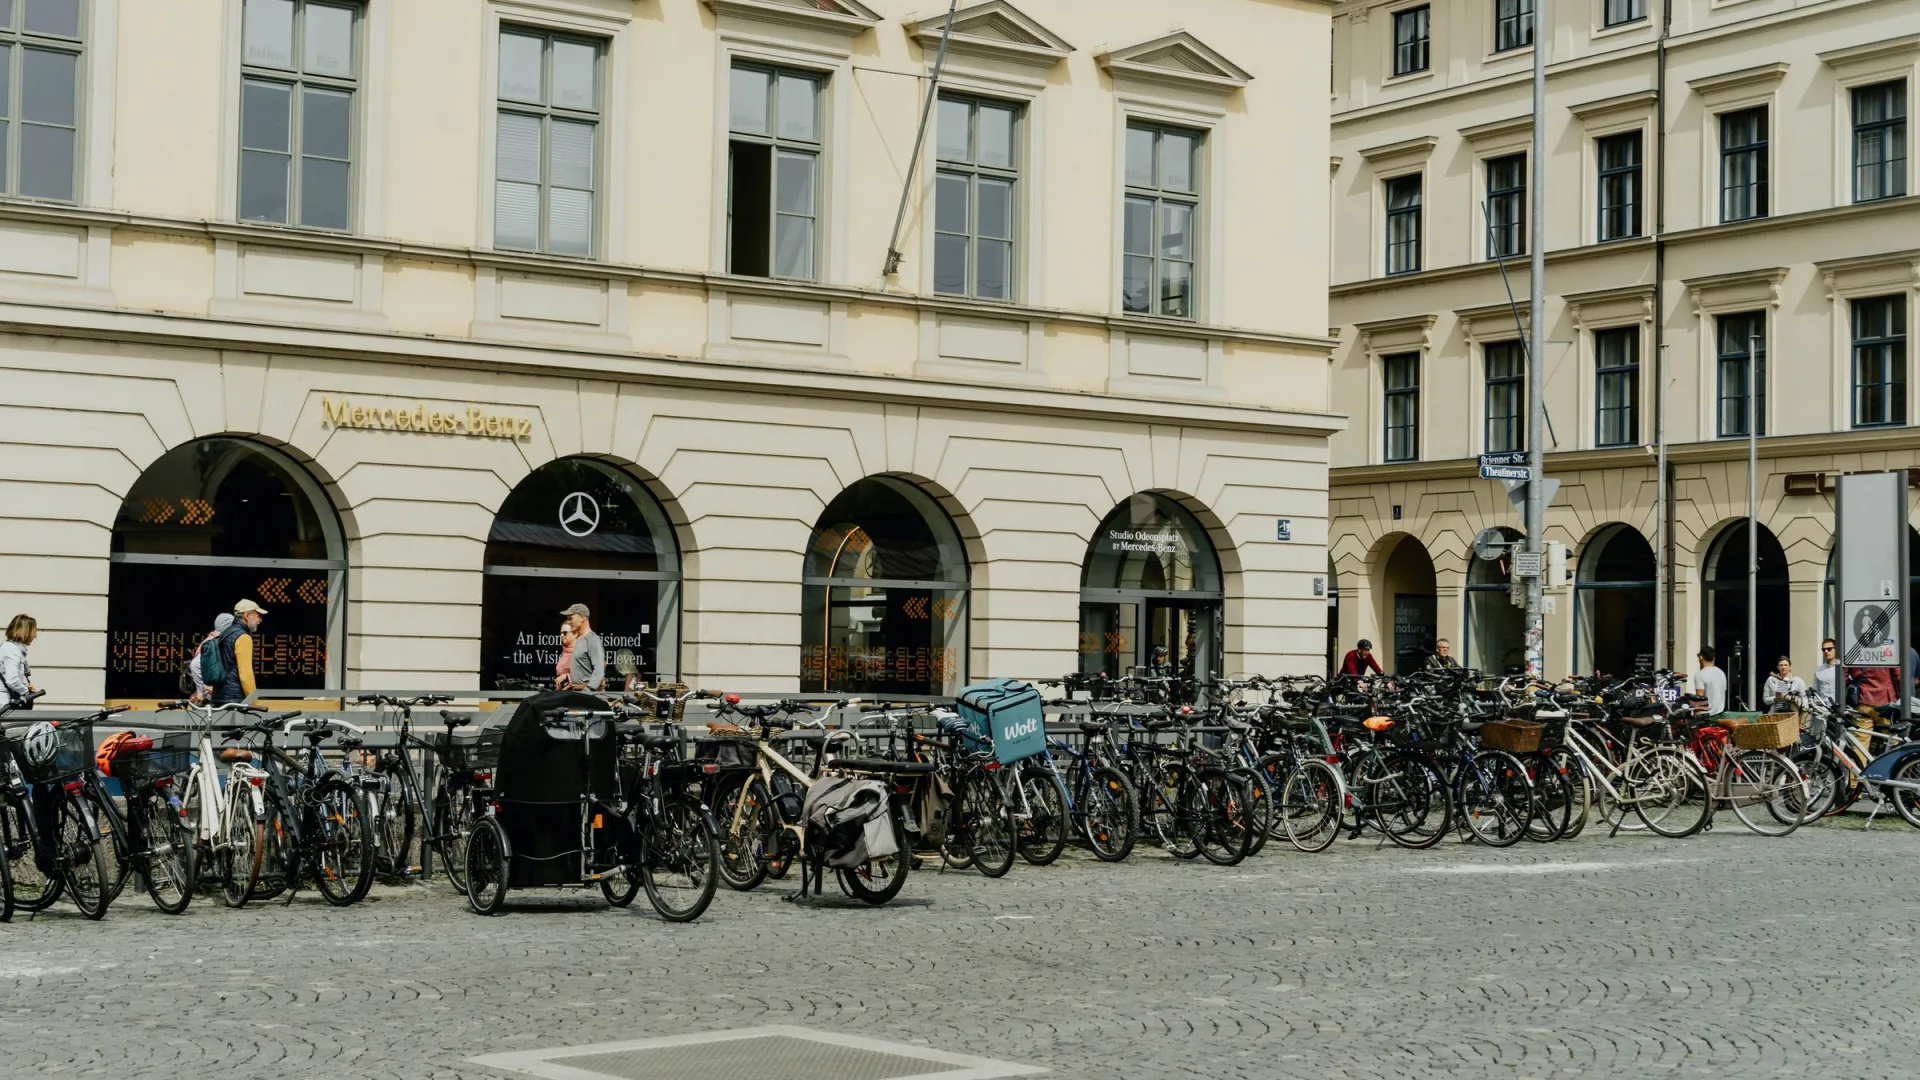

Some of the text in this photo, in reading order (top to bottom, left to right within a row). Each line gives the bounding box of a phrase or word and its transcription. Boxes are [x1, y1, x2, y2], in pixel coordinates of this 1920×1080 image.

[322, 396, 533, 439] Mercedes-Benz
[1480, 453, 1525, 465] Brienner Str.
[1484, 466, 1528, 478] Theatinerstr.
[1109, 530, 1179, 542] Studio Odeonsplatz
[1112, 541, 1176, 552] BY Mercedes-Benz
[1395, 616, 1408, 624] on
[1395, 624, 1426, 633] nature
[114, 631, 184, 645] VISION
[516, 631, 535, 646] An
[113, 645, 184, 659] VISION
[513, 649, 533, 664] the
[536, 650, 562, 665] Visi
[113, 659, 184, 673] VISION
[1004, 717, 1038, 740] Wolt
